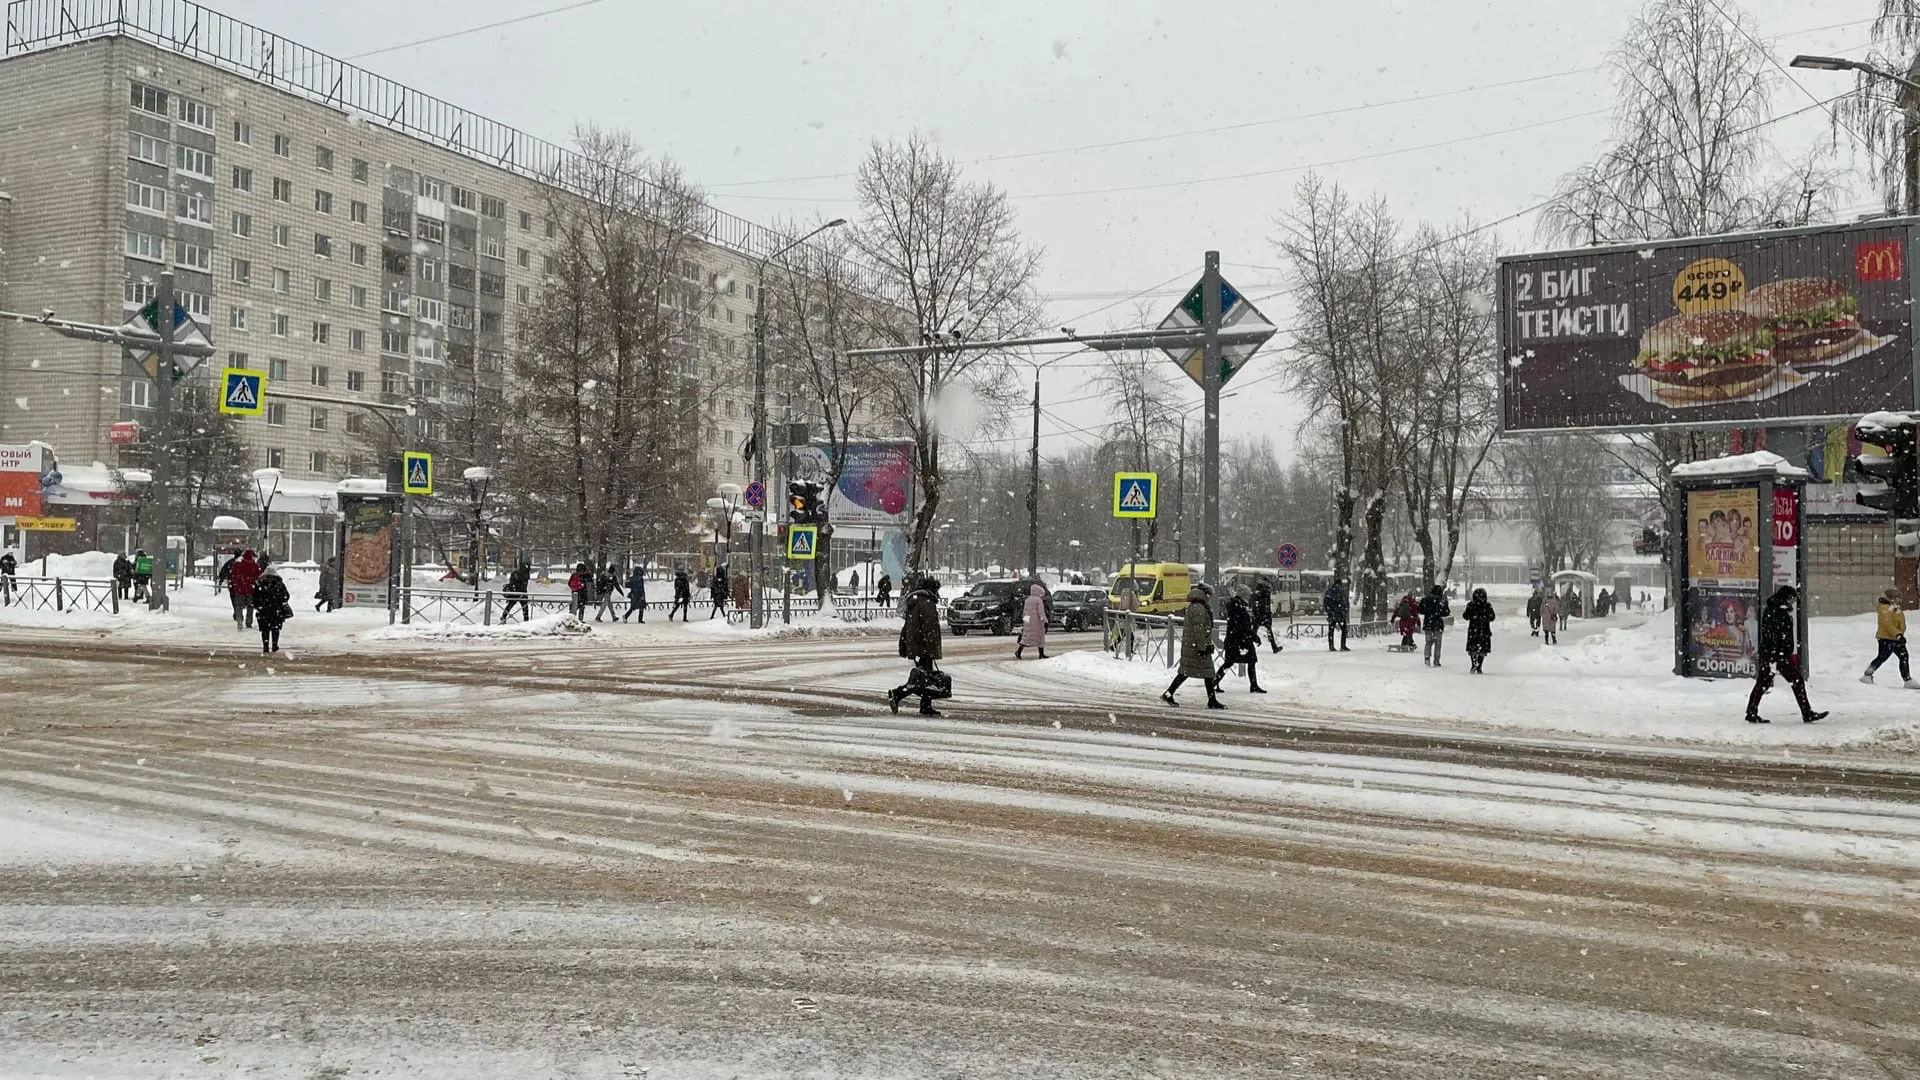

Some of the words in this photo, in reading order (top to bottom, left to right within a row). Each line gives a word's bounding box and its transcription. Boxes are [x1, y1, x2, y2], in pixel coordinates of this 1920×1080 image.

[1518, 272, 1534, 301] 2
[1541, 267, 1597, 299] БИГ
[1517, 299, 1629, 338] ТЕЙСТИ
[0, 448, 31, 459] ОВЫЙ
[0, 459, 20, 468] НТР
[1697, 659, 1756, 675] СЮРПРИЗ
